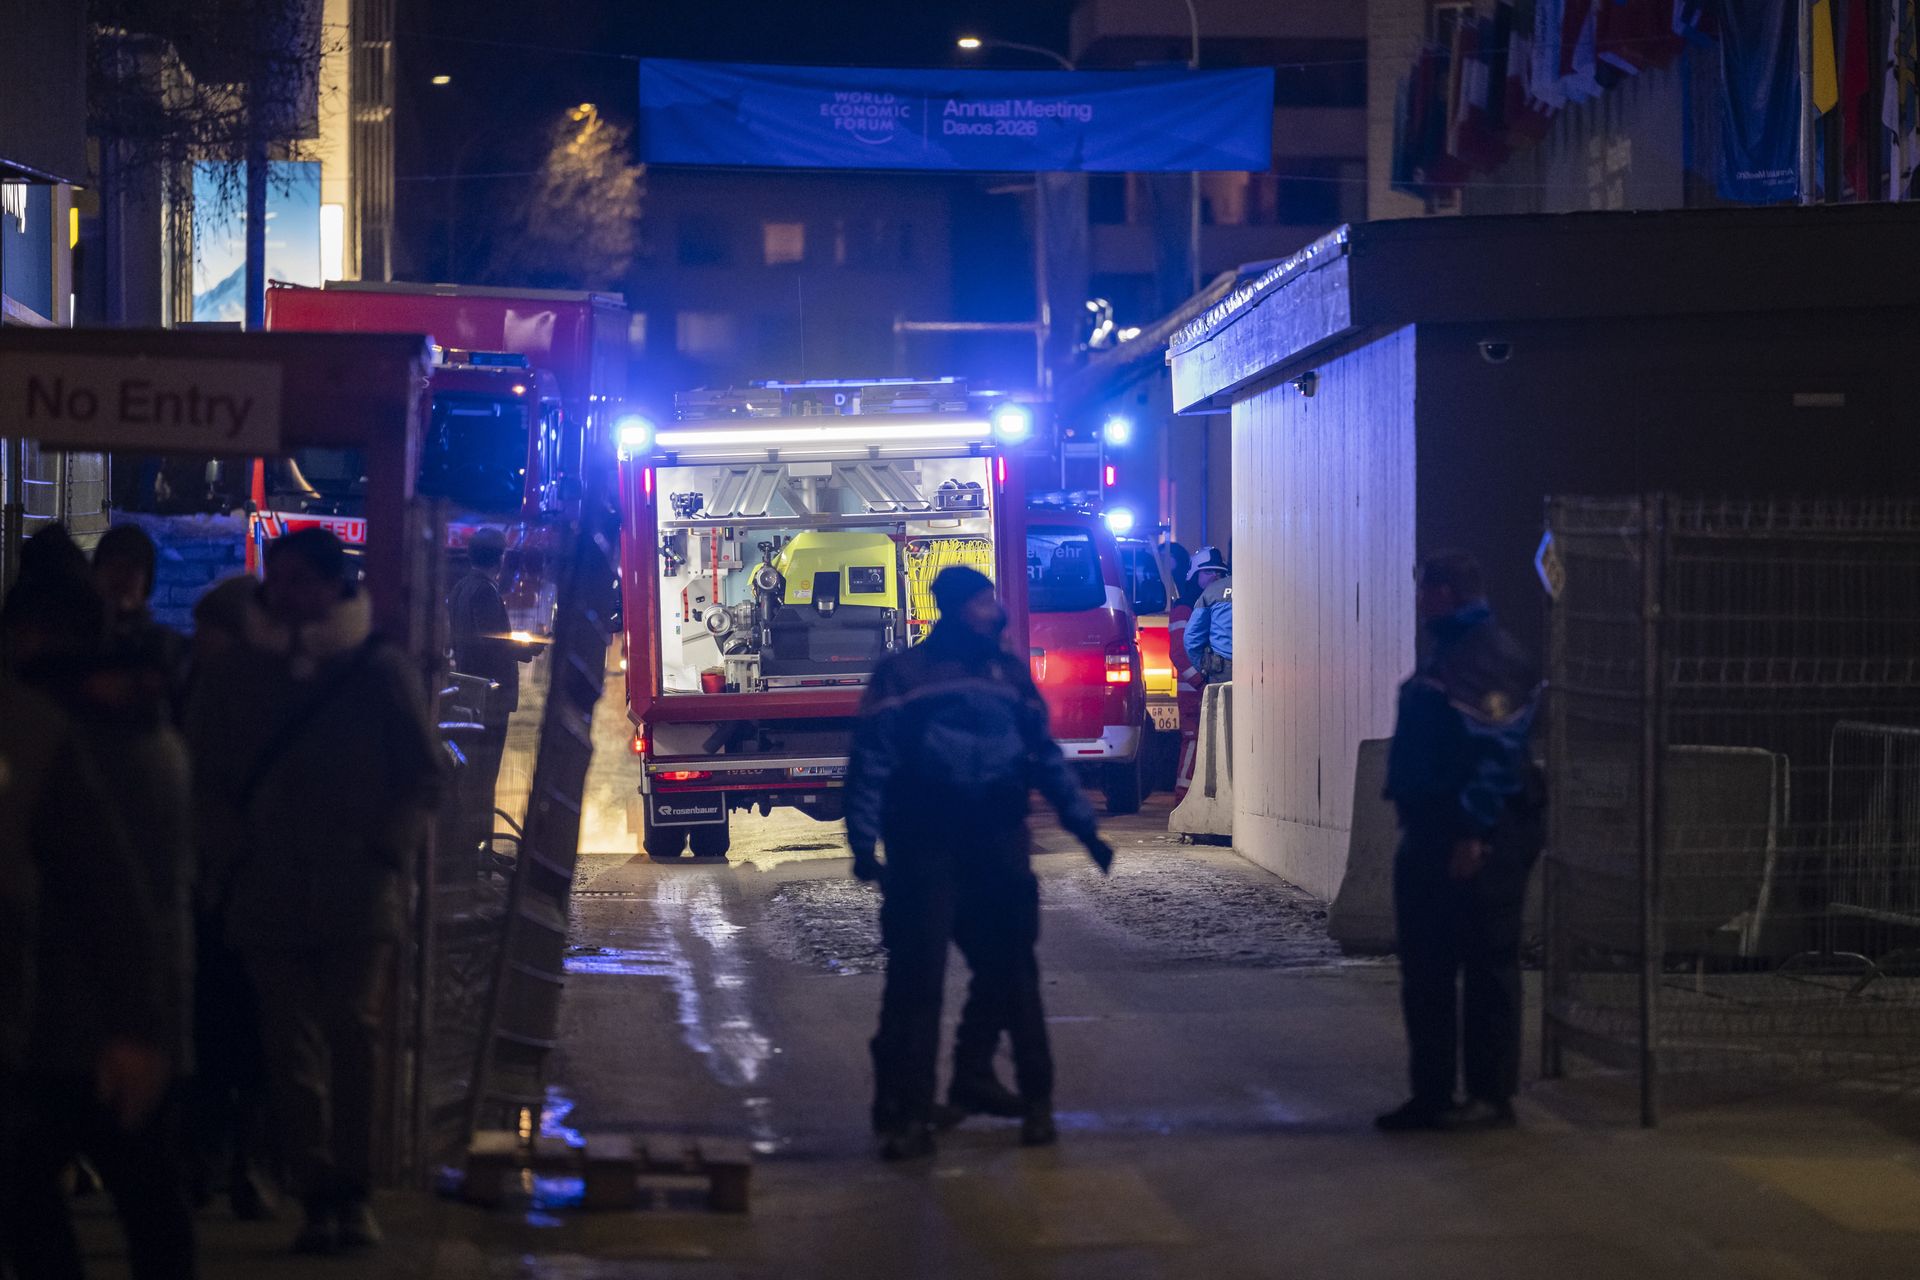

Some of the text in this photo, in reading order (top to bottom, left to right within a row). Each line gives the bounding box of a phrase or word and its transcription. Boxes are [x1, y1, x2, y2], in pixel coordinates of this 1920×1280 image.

[834, 92, 895, 104] WORLD
[820, 104, 910, 118] ECONOMIC
[943, 99, 1092, 122] Annual Meeting
[834, 117, 894, 131] FORUM
[943, 120, 1037, 136] Davos 2026
[26, 375, 251, 438] No Entry
[1152, 707, 1163, 717] GR
[672, 806, 718, 815] rosenbauer
